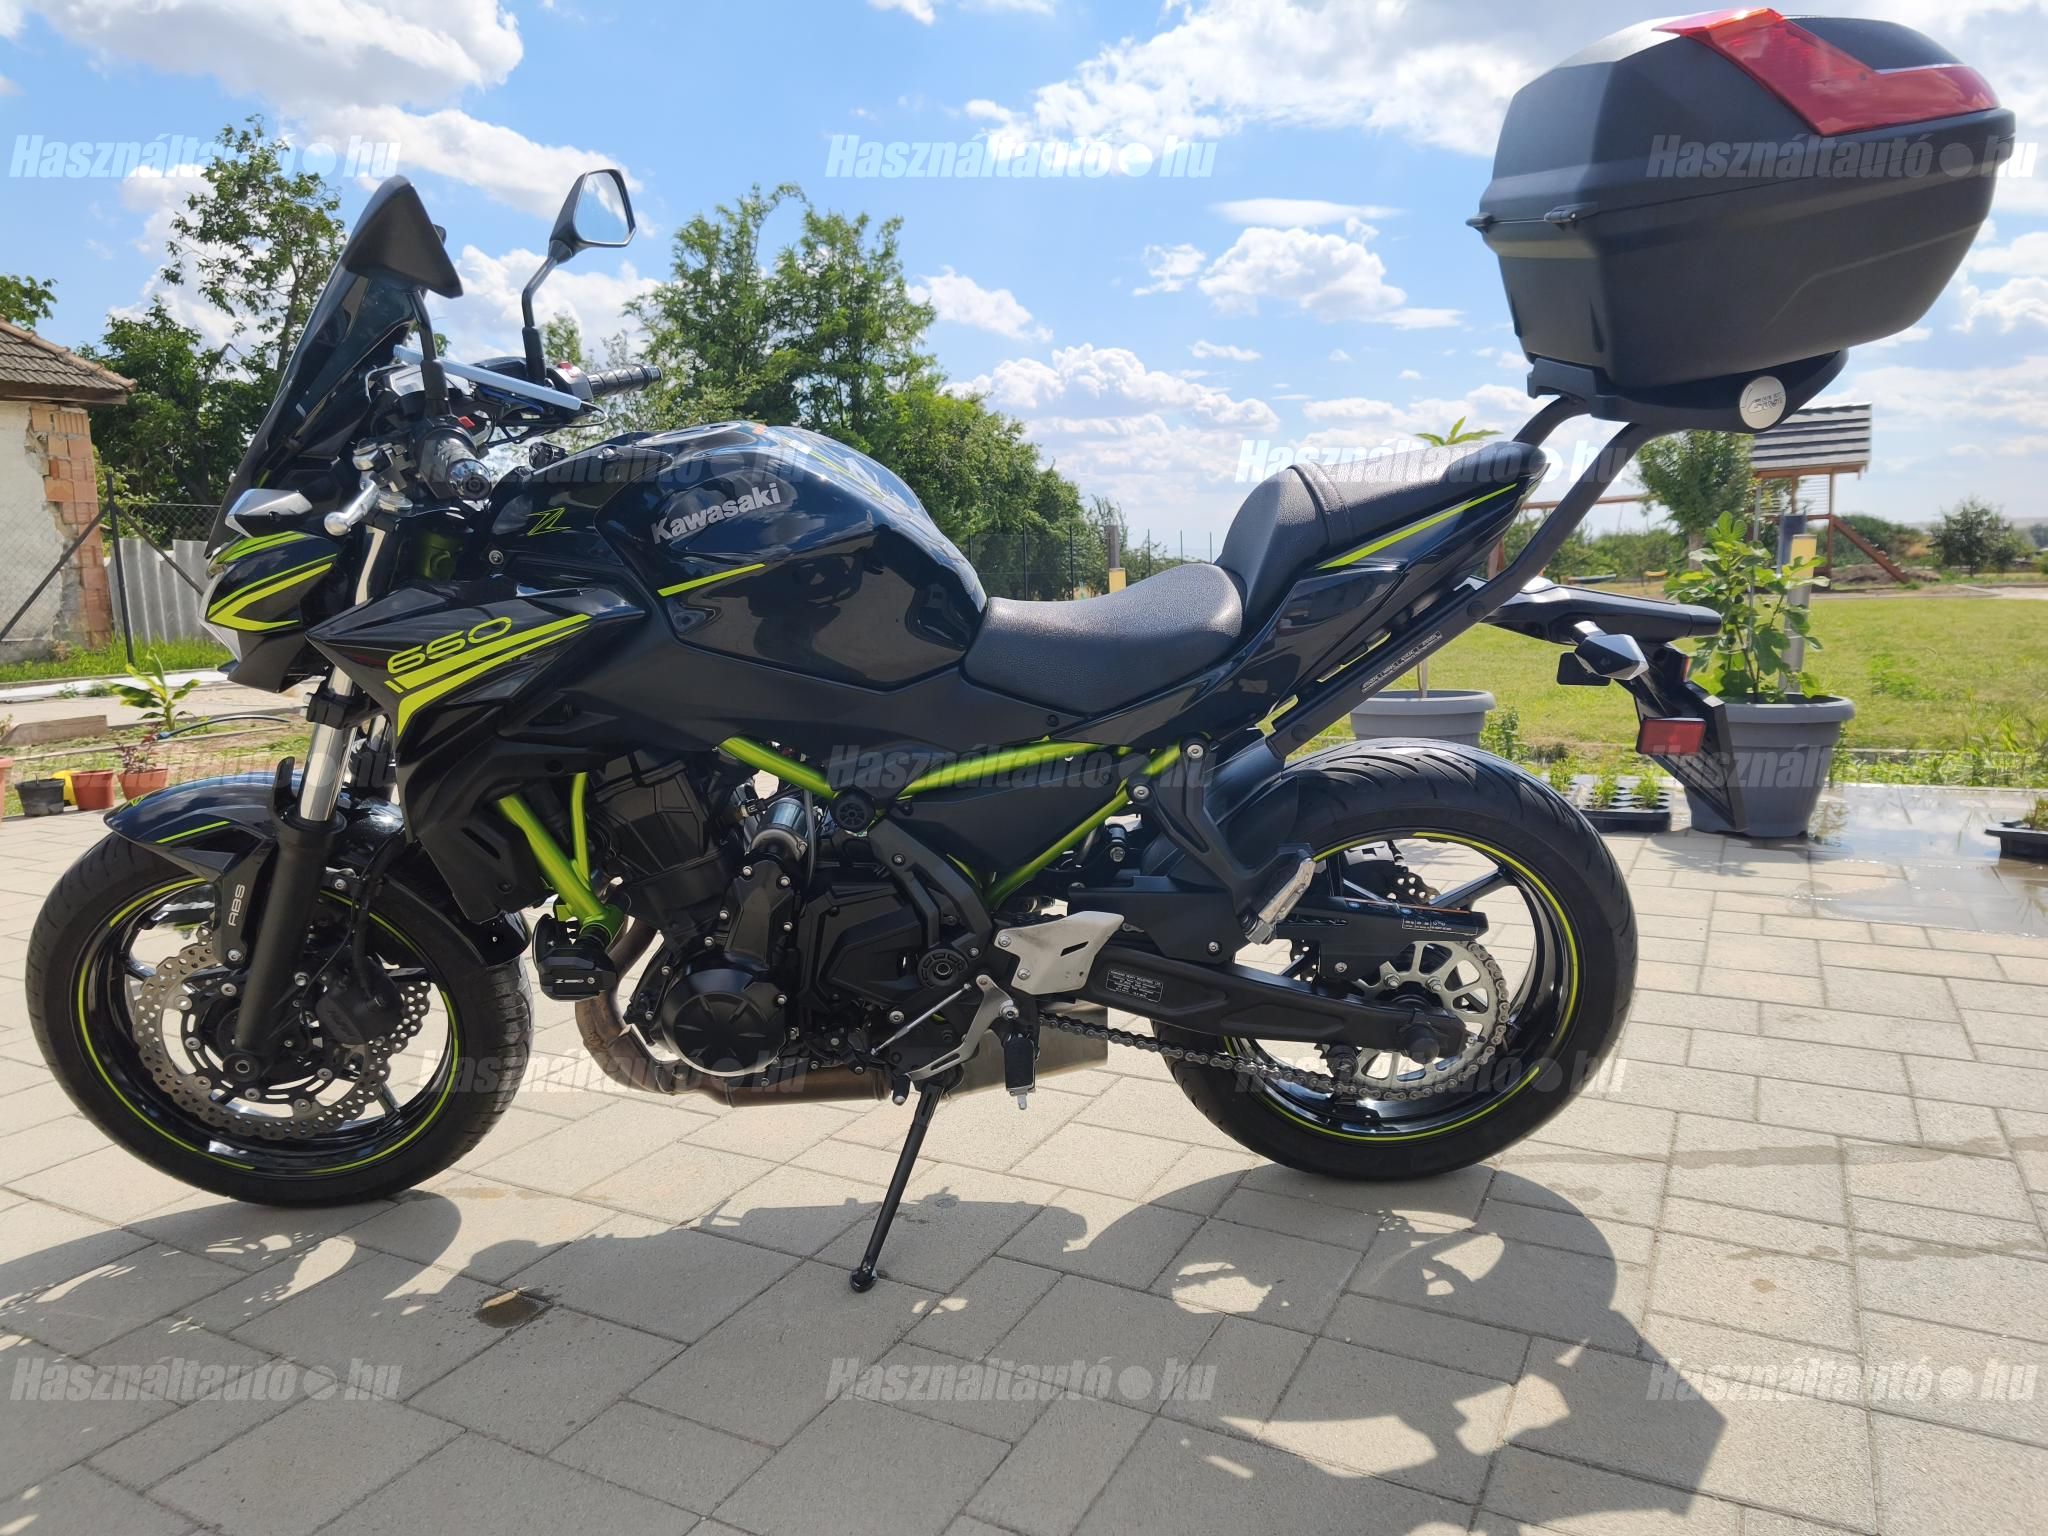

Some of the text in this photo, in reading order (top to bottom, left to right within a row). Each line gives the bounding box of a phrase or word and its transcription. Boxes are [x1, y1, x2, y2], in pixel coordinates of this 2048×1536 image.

[650, 483, 781, 544] Kawasaki
[387, 616, 512, 674] 650
[228, 883, 246, 927] ABS
